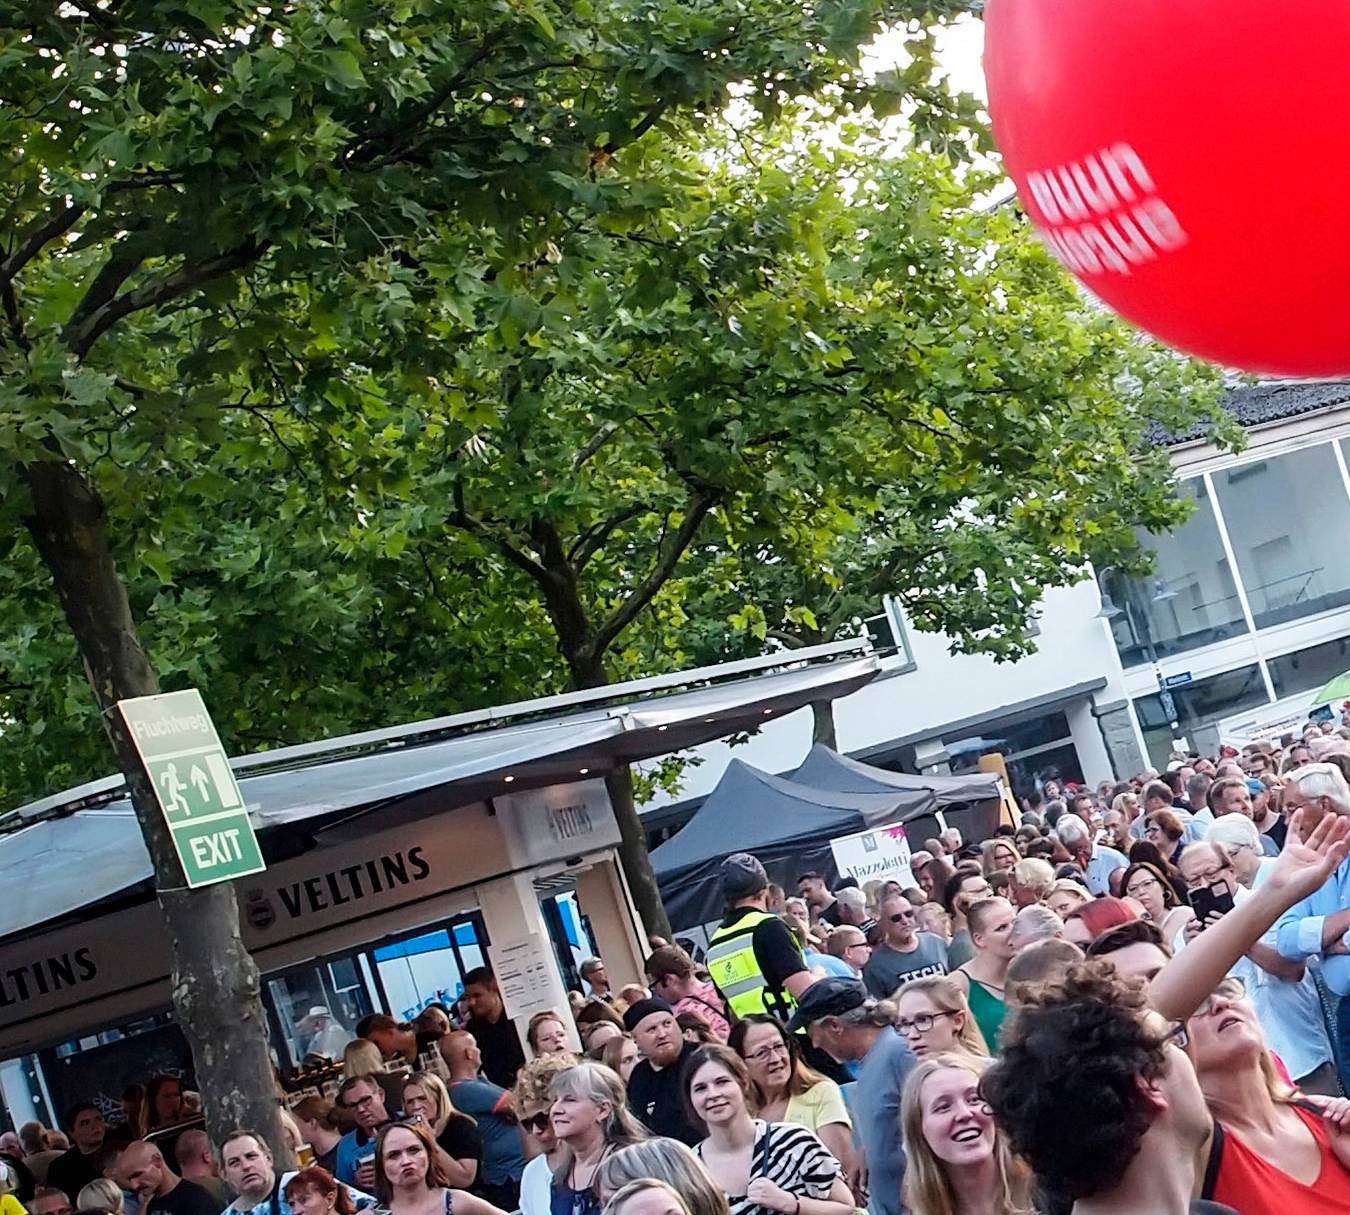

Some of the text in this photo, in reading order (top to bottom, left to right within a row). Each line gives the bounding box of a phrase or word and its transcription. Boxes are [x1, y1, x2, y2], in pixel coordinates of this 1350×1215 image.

[132, 712, 209, 739] Fluchtweg
[189, 828, 243, 870] EXIT
[277, 846, 430, 919] VELTINS
